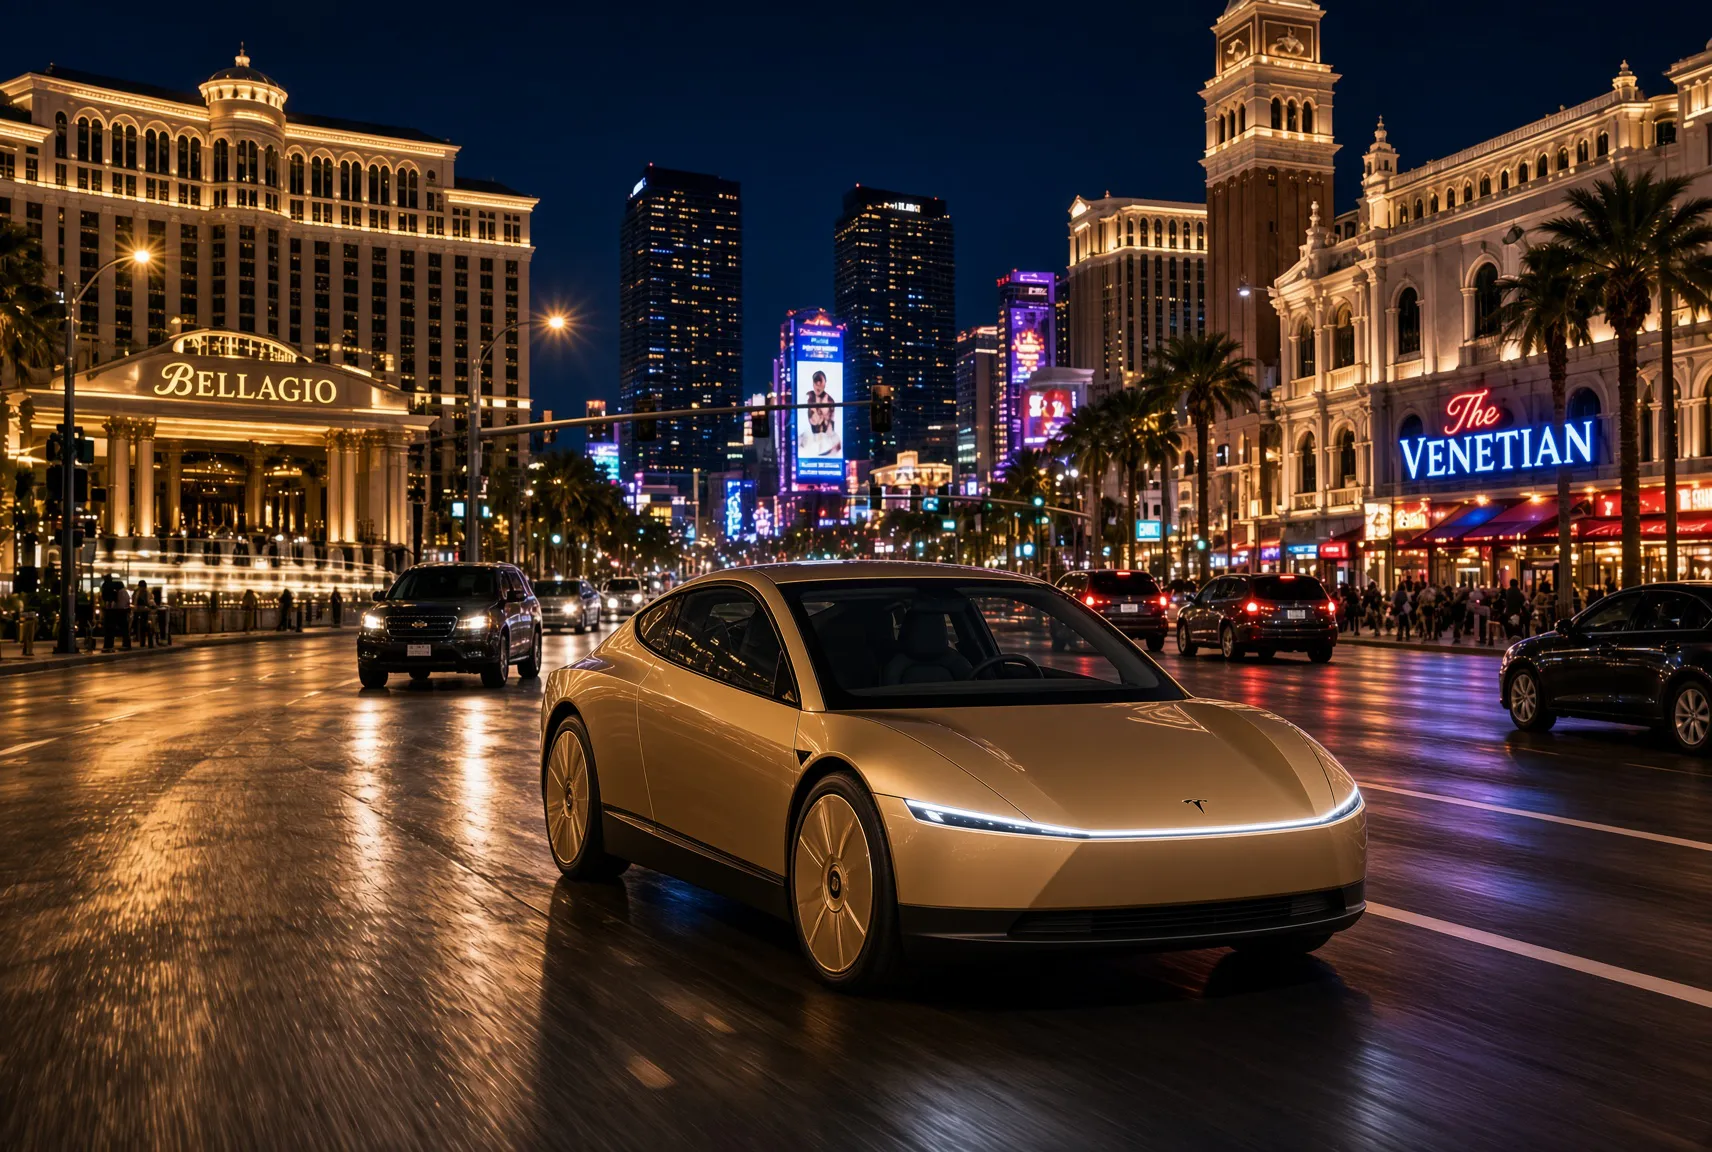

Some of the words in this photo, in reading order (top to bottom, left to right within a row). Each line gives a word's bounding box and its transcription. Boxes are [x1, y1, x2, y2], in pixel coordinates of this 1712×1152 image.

[153, 362, 337, 404] BELLAGIO
[1444, 389, 1500, 435] The
[1400, 420, 1592, 480] VENETIAN
